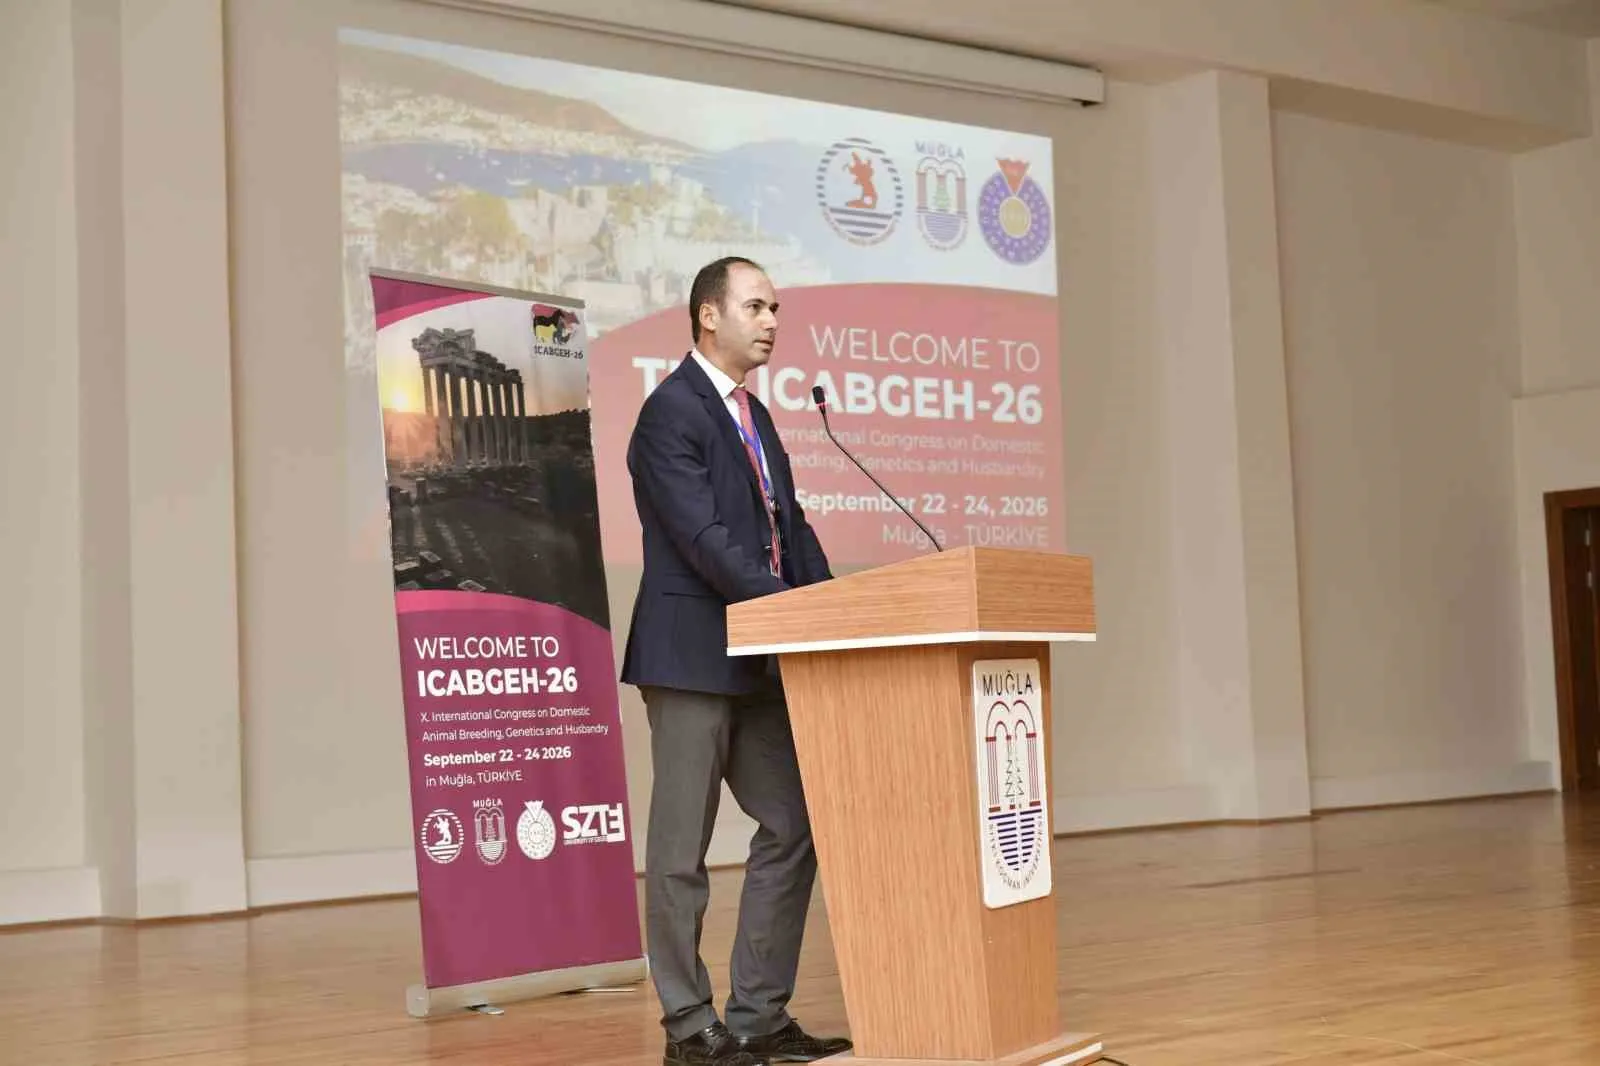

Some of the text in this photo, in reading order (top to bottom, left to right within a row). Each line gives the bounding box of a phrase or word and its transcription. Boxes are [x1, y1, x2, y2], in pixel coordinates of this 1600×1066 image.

[534, 345, 584, 360] ICABGEH-26
[810, 324, 1041, 373] WELCOME TO
[757, 366, 1043, 425] ICABGEH-26
[870, 429, 945, 451] Congress
[948, 436, 968, 450] on
[973, 434, 1044, 454] Domestic
[927, 458, 959, 474] and
[961, 460, 1045, 480] Husbandry
[796, 488, 917, 516] September
[922, 493, 946, 514] 22
[964, 495, 995, 518] 24,
[1000, 496, 1048, 517] 2026
[414, 636, 560, 659] WELCOME TO
[417, 666, 578, 697] ICABGEH-26
[982, 670, 1034, 697] MUĞLA
[420, 706, 591, 722] X. International Congress on Domestic
[422, 723, 609, 742] Animal Breeding, Genetics and Husbandry
[424, 750, 496, 768] September
[499, 749, 513, 762] 22
[524, 747, 540, 760] 24
[542, 746, 572, 759] 2026
[426, 775, 437, 787] in
[477, 768, 523, 783] TÜRKİYE
